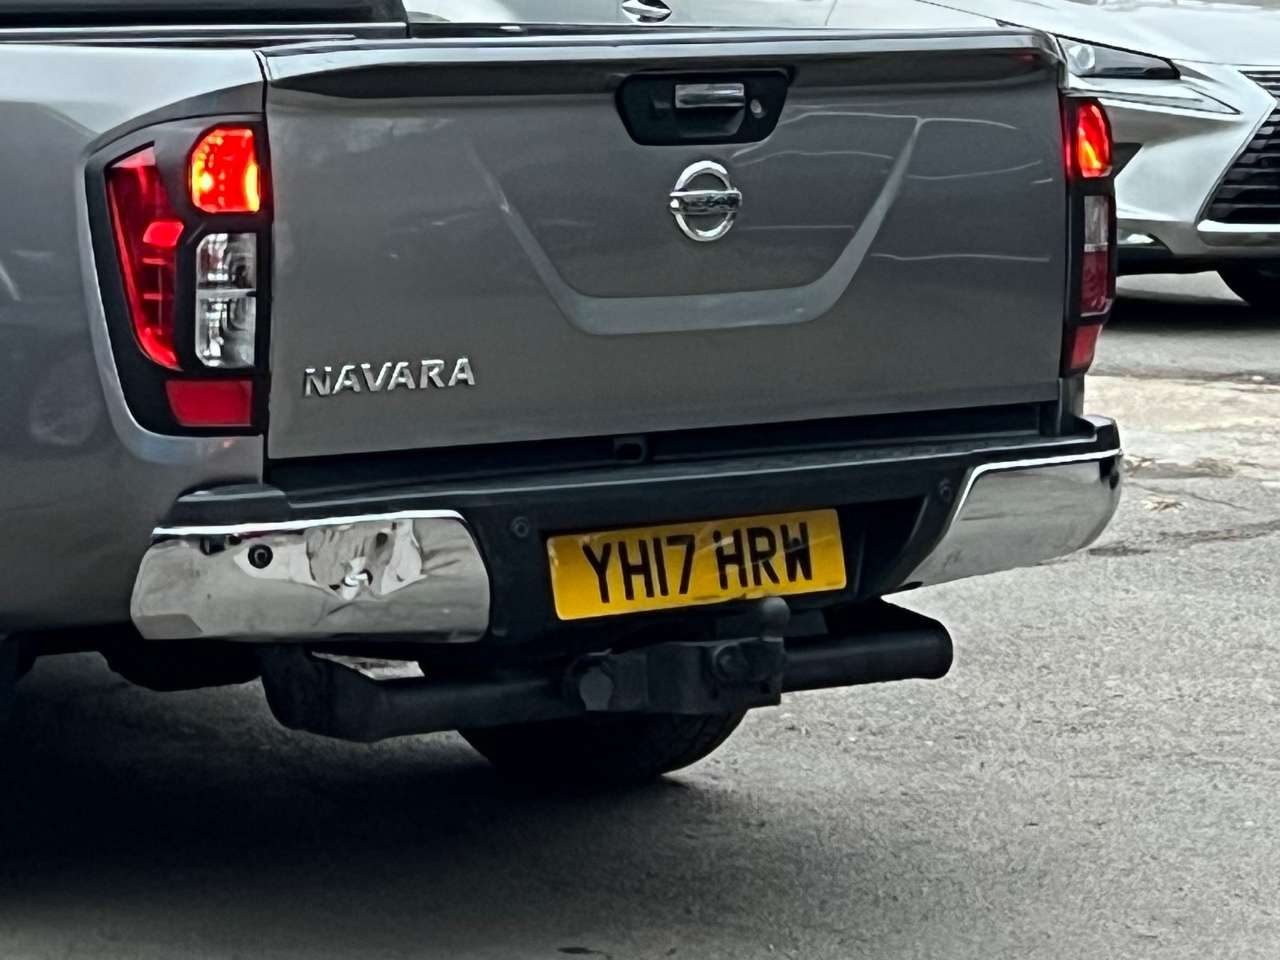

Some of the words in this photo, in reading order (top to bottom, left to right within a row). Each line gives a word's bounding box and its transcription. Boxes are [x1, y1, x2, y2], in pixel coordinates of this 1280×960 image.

[304, 357, 476, 397] NAVARA
[581, 534, 697, 604] YH17
[712, 521, 813, 591] HRW
